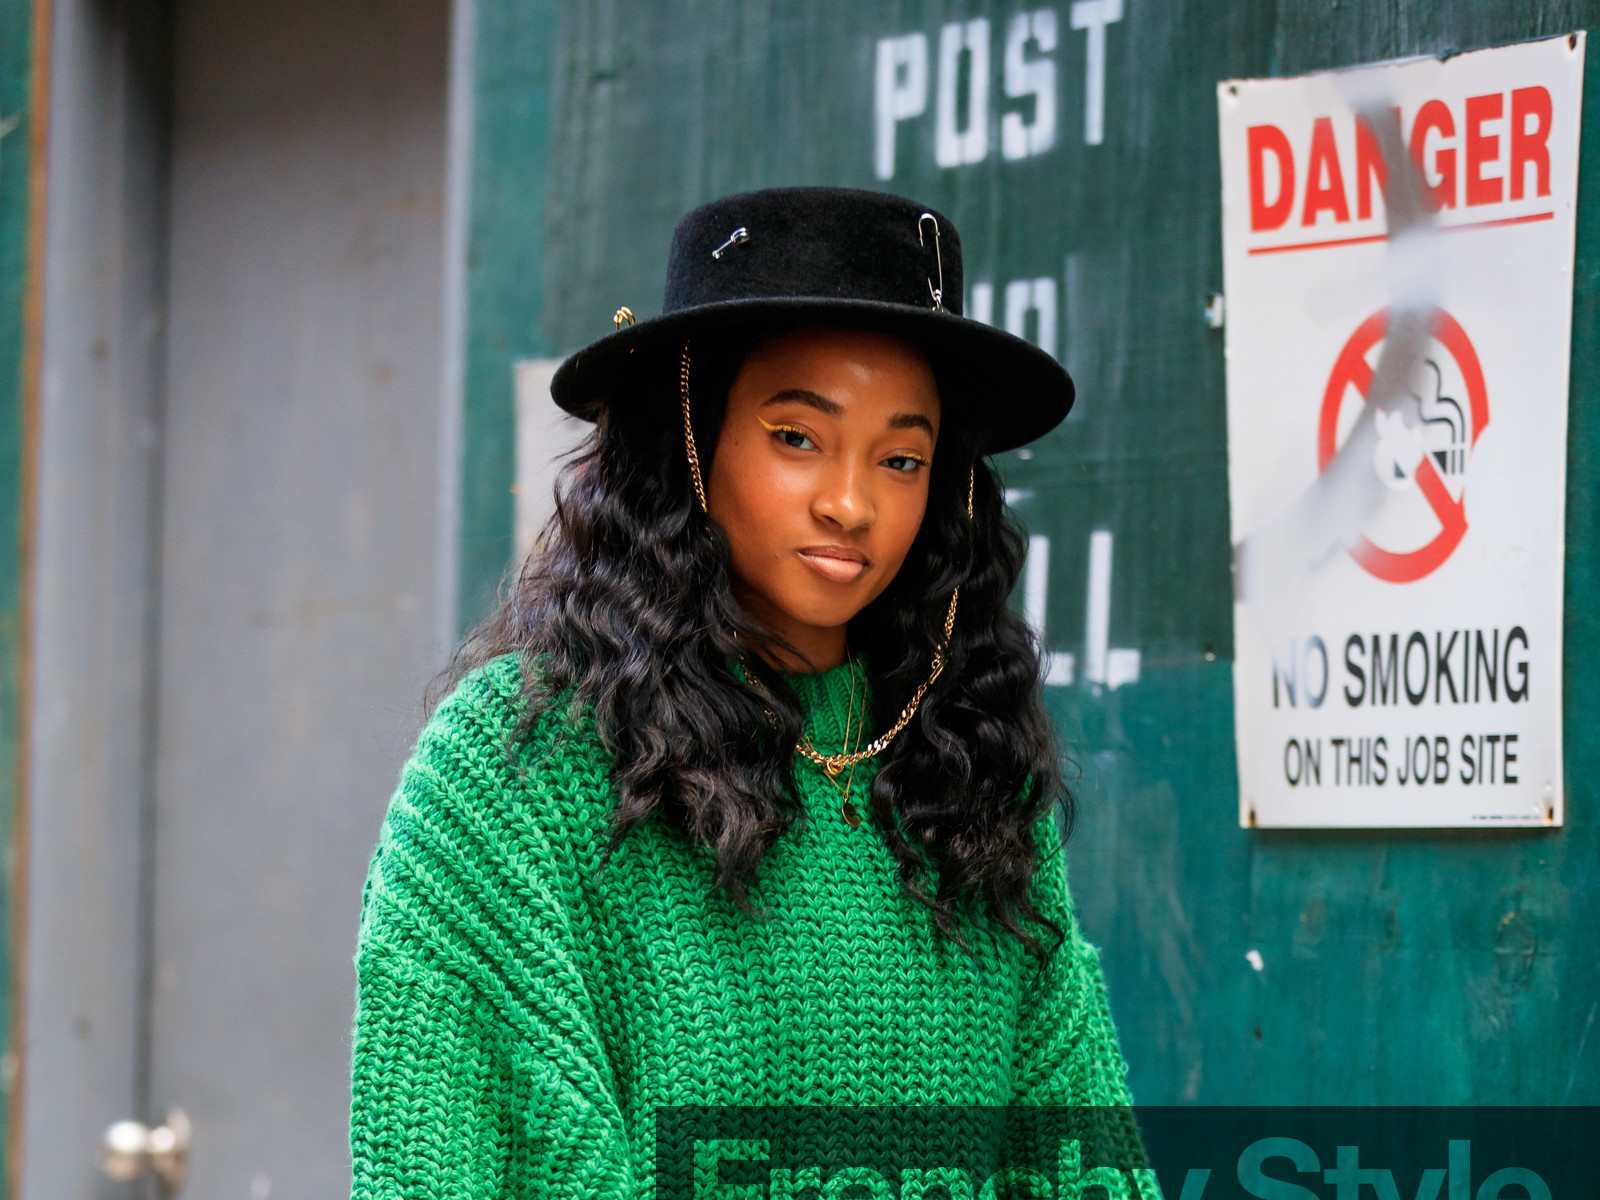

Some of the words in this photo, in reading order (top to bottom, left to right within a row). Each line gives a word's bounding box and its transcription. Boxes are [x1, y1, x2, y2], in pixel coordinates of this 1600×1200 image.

[875, 0, 1125, 181] POST
[1343, 626, 1530, 708] SMOKING
[1284, 738, 1321, 787] ON
[1331, 736, 1388, 786] THIS
[1397, 735, 1450, 786] JOB
[1460, 734, 1519, 786] SITE
